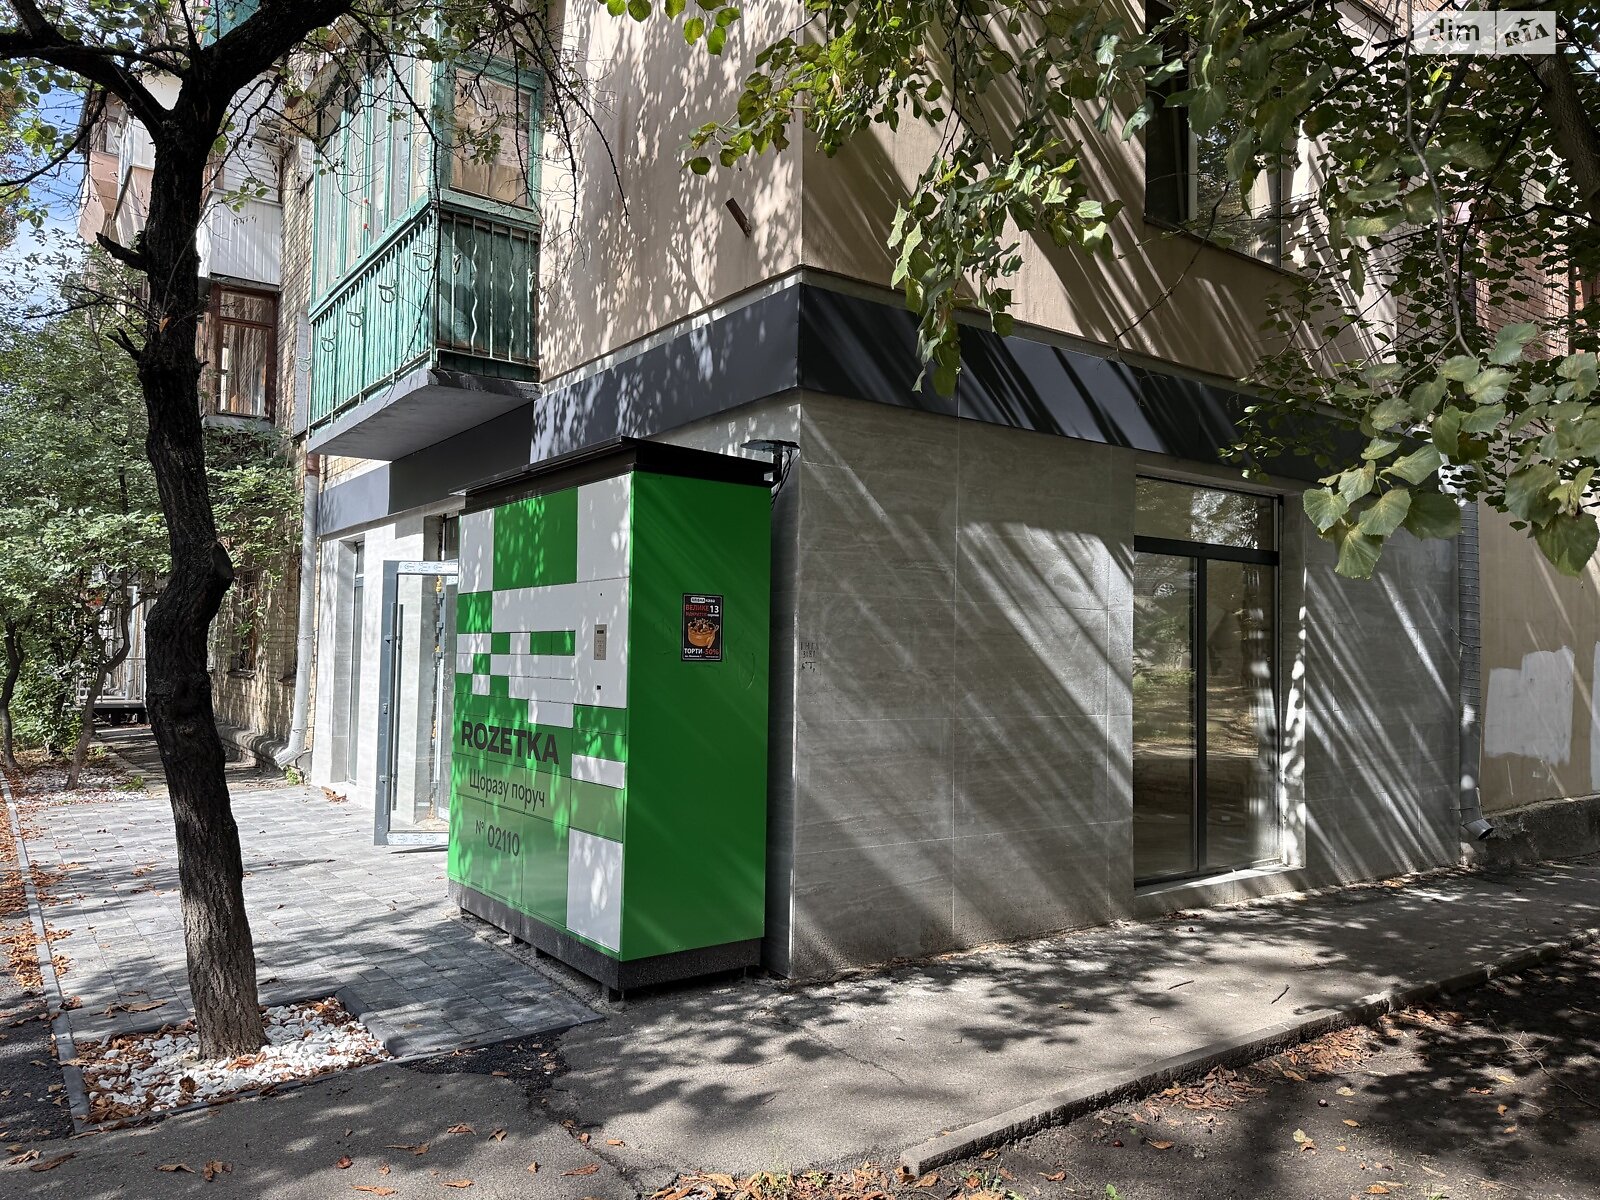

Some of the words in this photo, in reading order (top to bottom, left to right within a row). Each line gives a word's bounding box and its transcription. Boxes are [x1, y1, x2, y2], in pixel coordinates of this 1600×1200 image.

[710, 605, 719, 613] 13
[461, 720, 560, 765] ROZETKA
[469, 768, 510, 803] Щоразу
[511, 783, 546, 811] поруч
[487, 824, 521, 857] 02110
